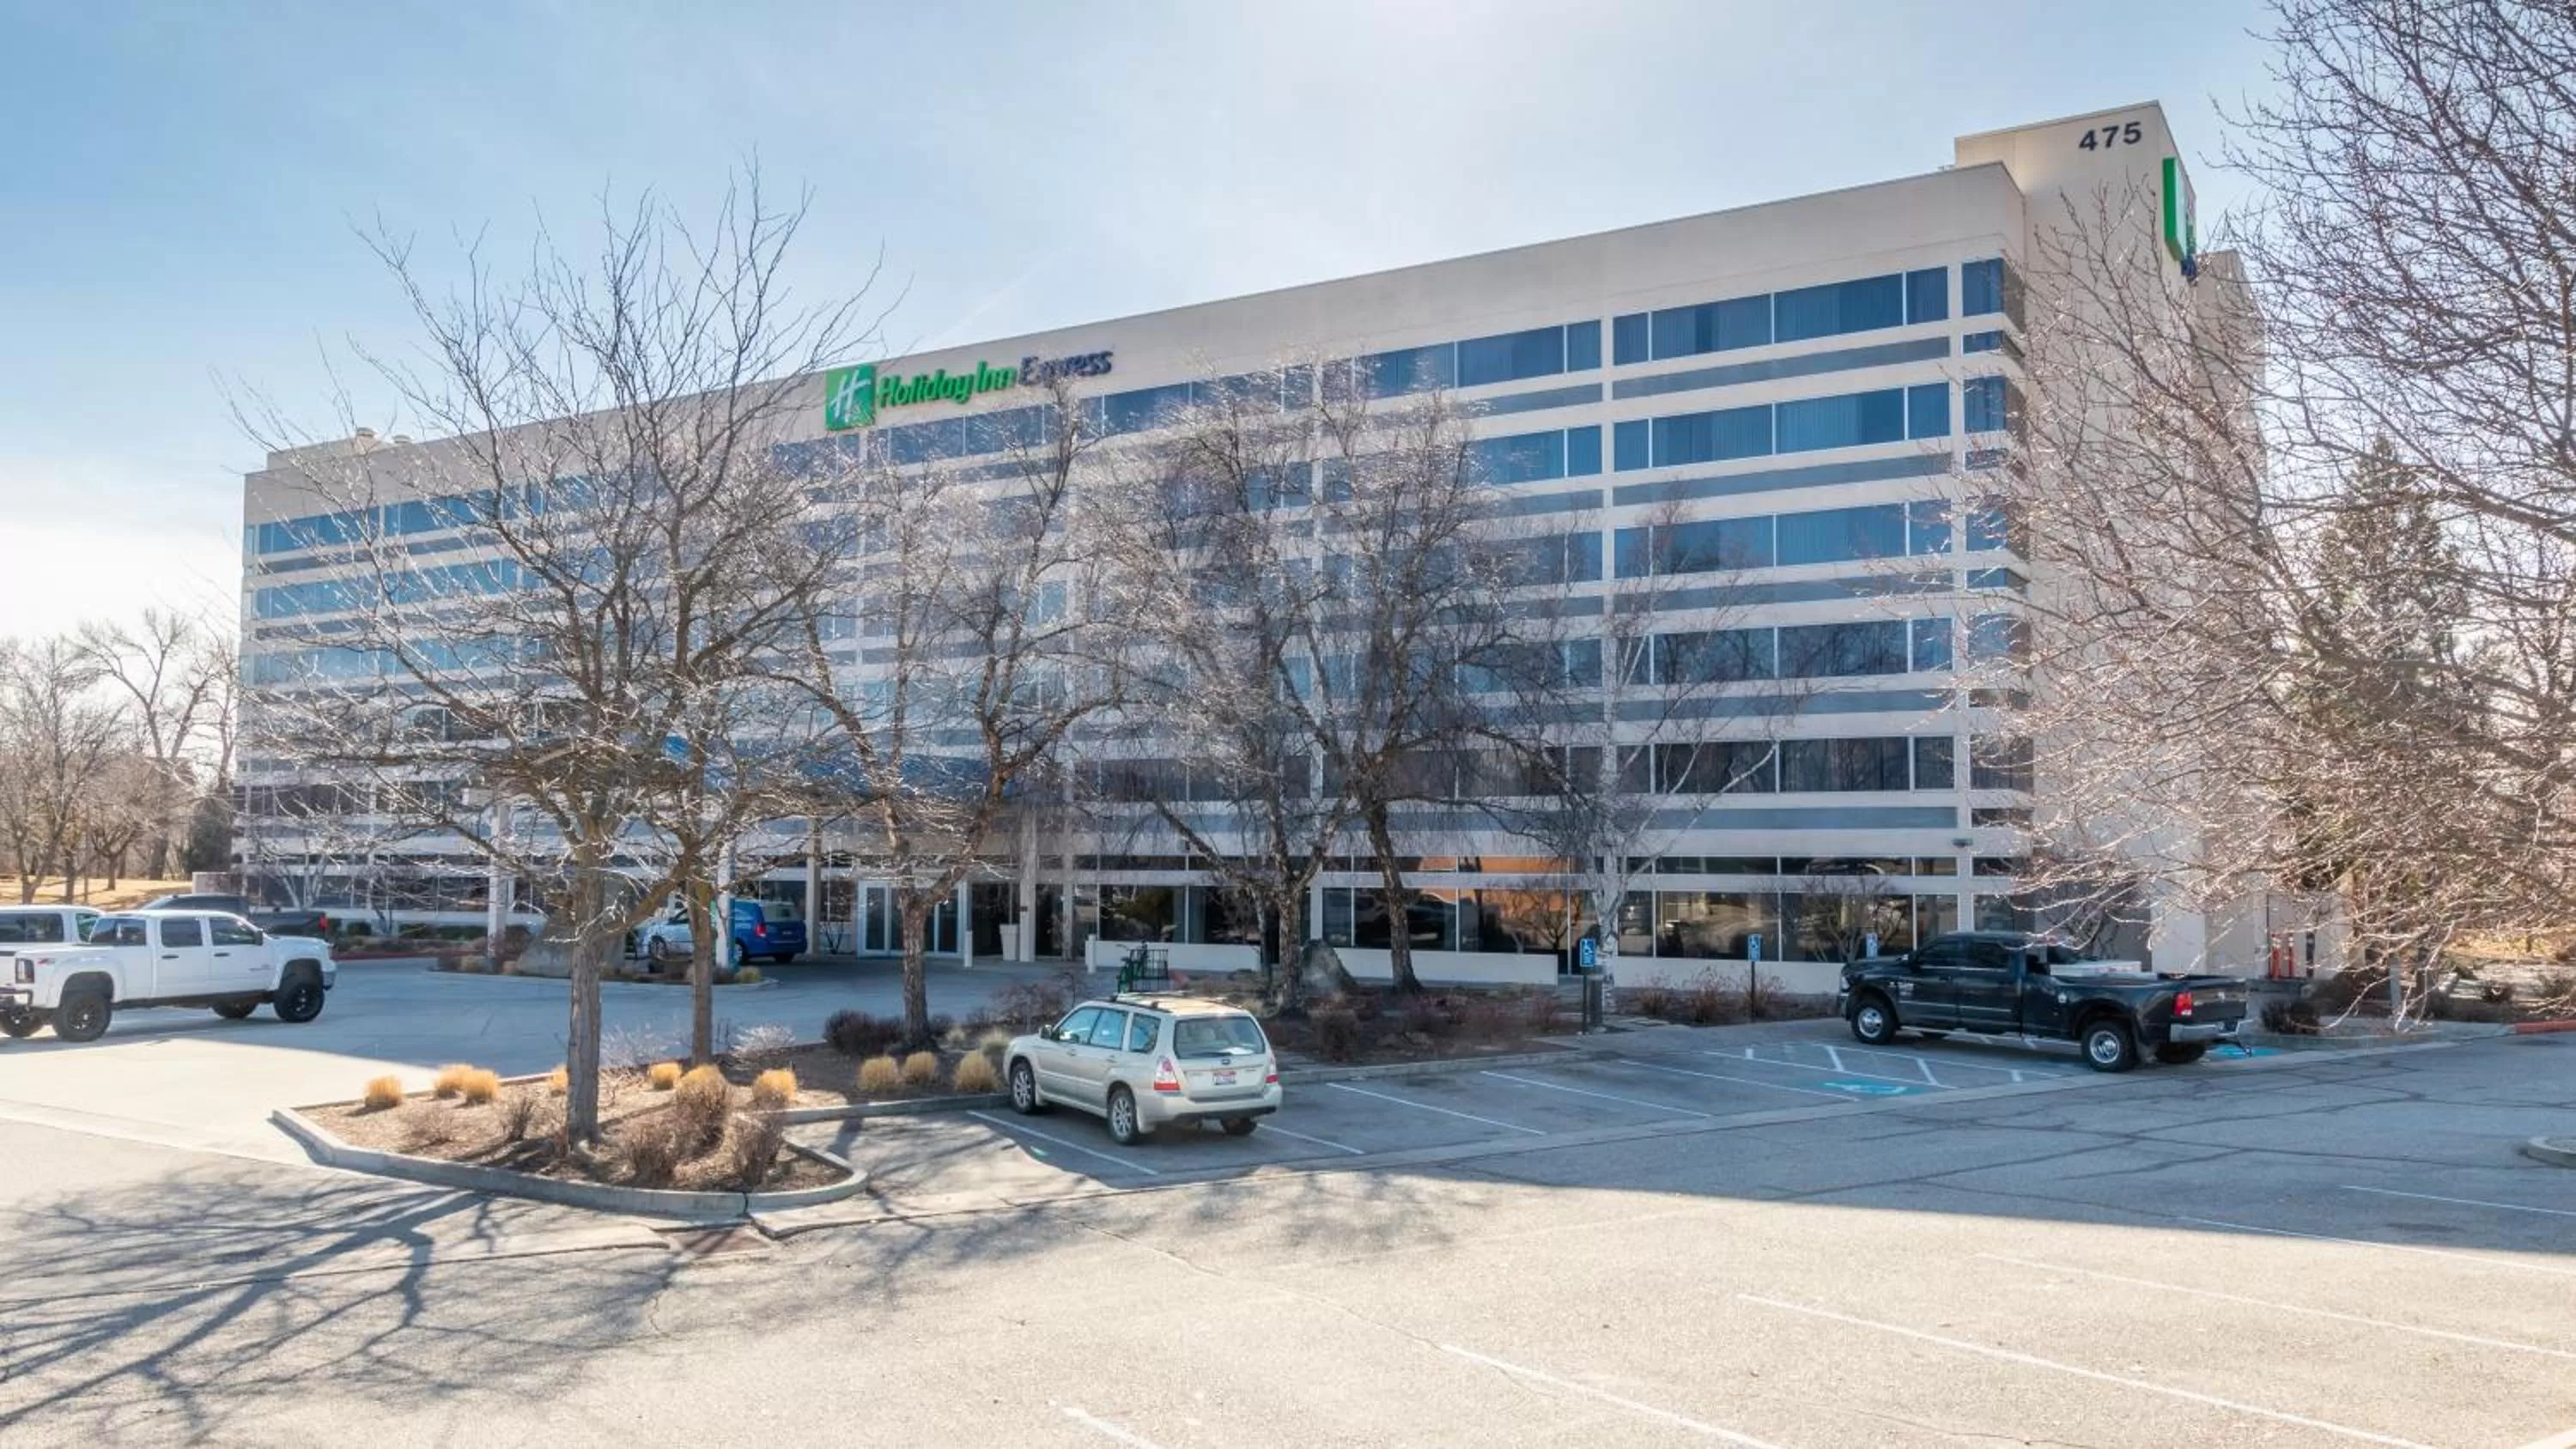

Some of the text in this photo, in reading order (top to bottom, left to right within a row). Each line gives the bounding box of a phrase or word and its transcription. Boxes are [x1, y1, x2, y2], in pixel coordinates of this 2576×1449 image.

[2079, 121, 2142, 152] 475
[879, 367, 974, 408] Holiday
[976, 361, 1018, 393] Inn
